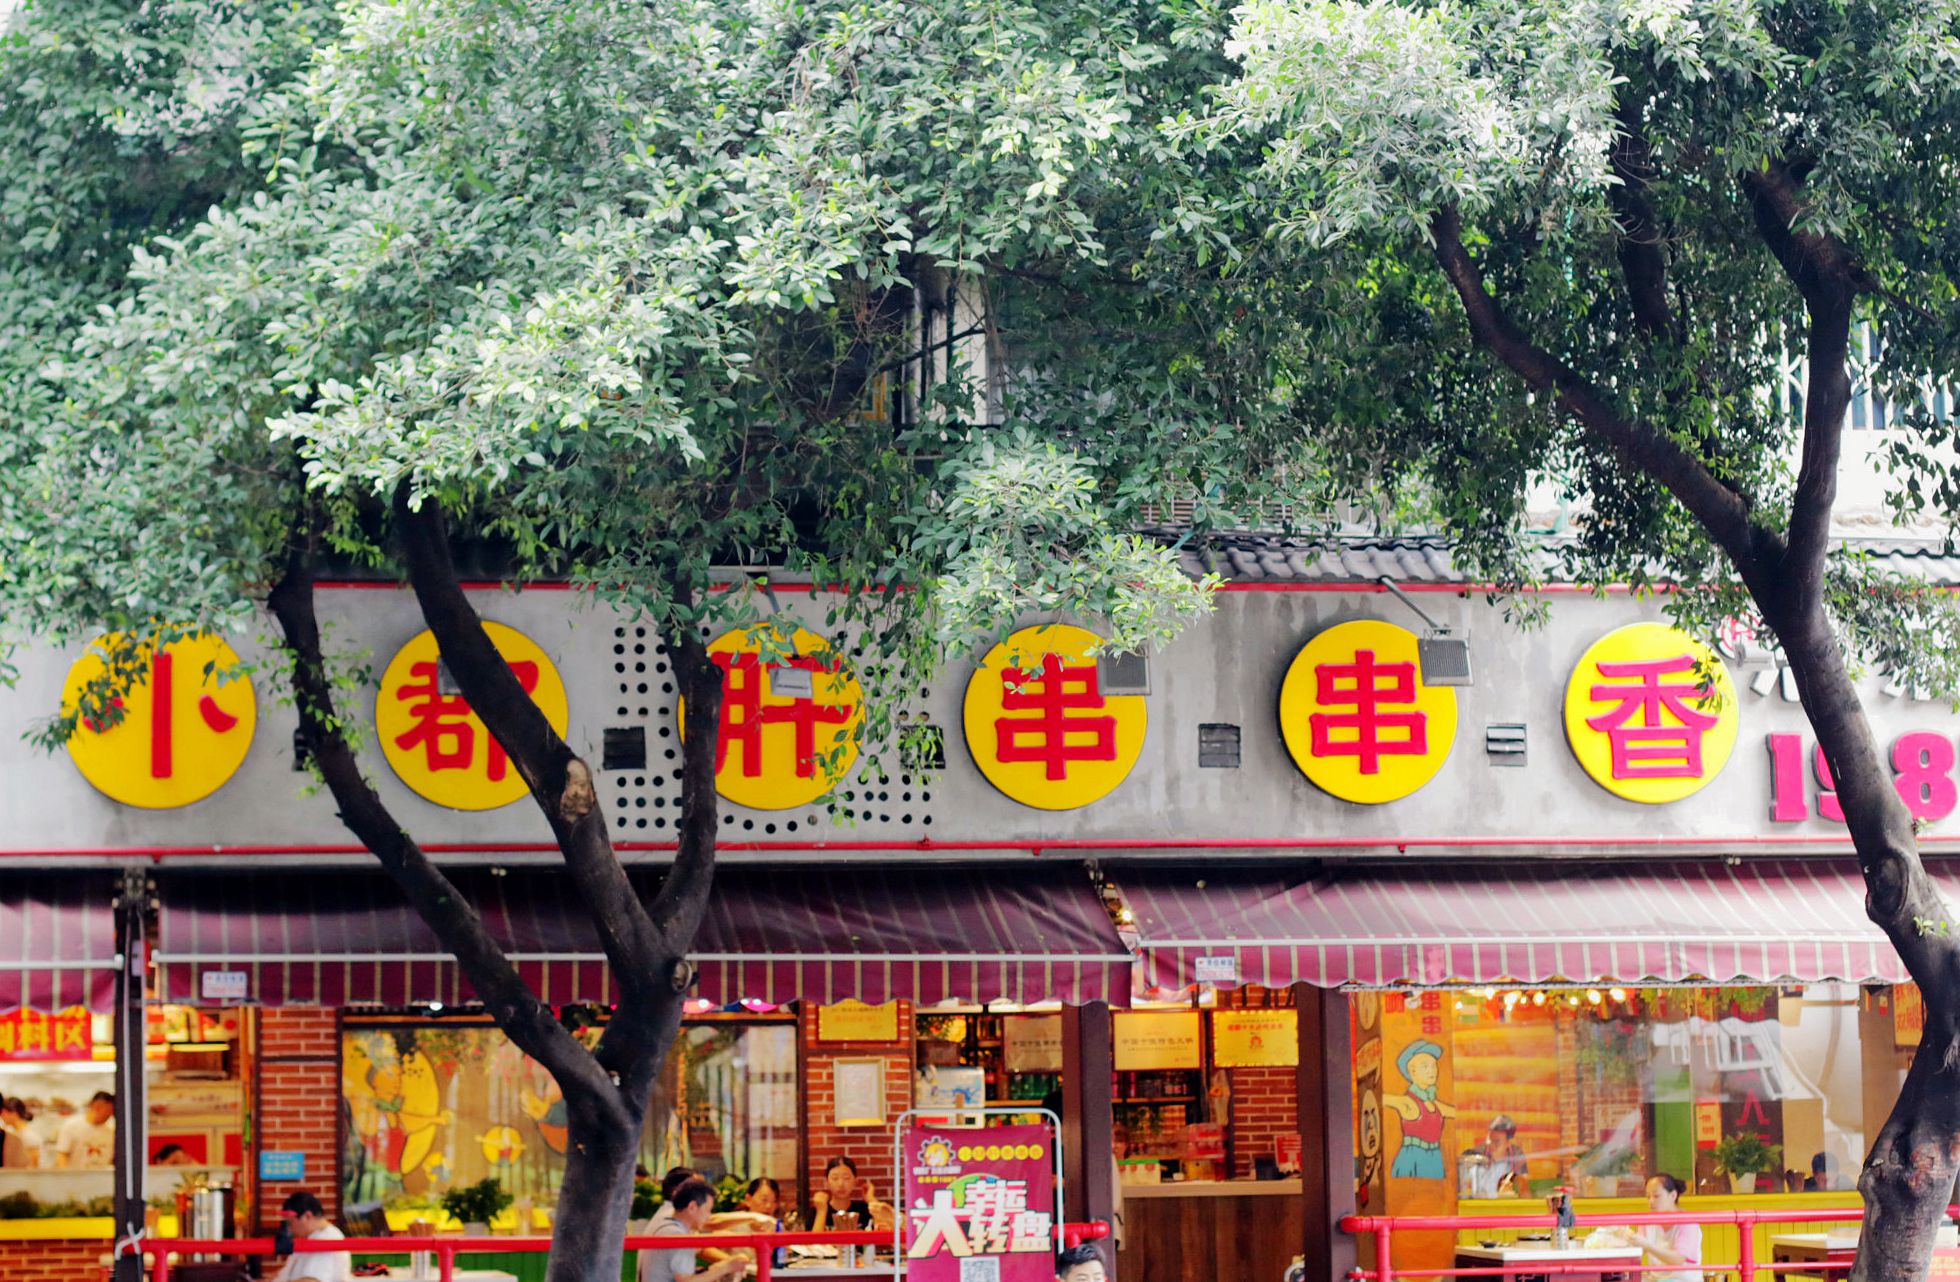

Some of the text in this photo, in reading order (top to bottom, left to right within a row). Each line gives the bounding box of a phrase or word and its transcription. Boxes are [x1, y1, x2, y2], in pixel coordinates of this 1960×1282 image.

[83, 650, 1718, 782] 小郡肝串串香
